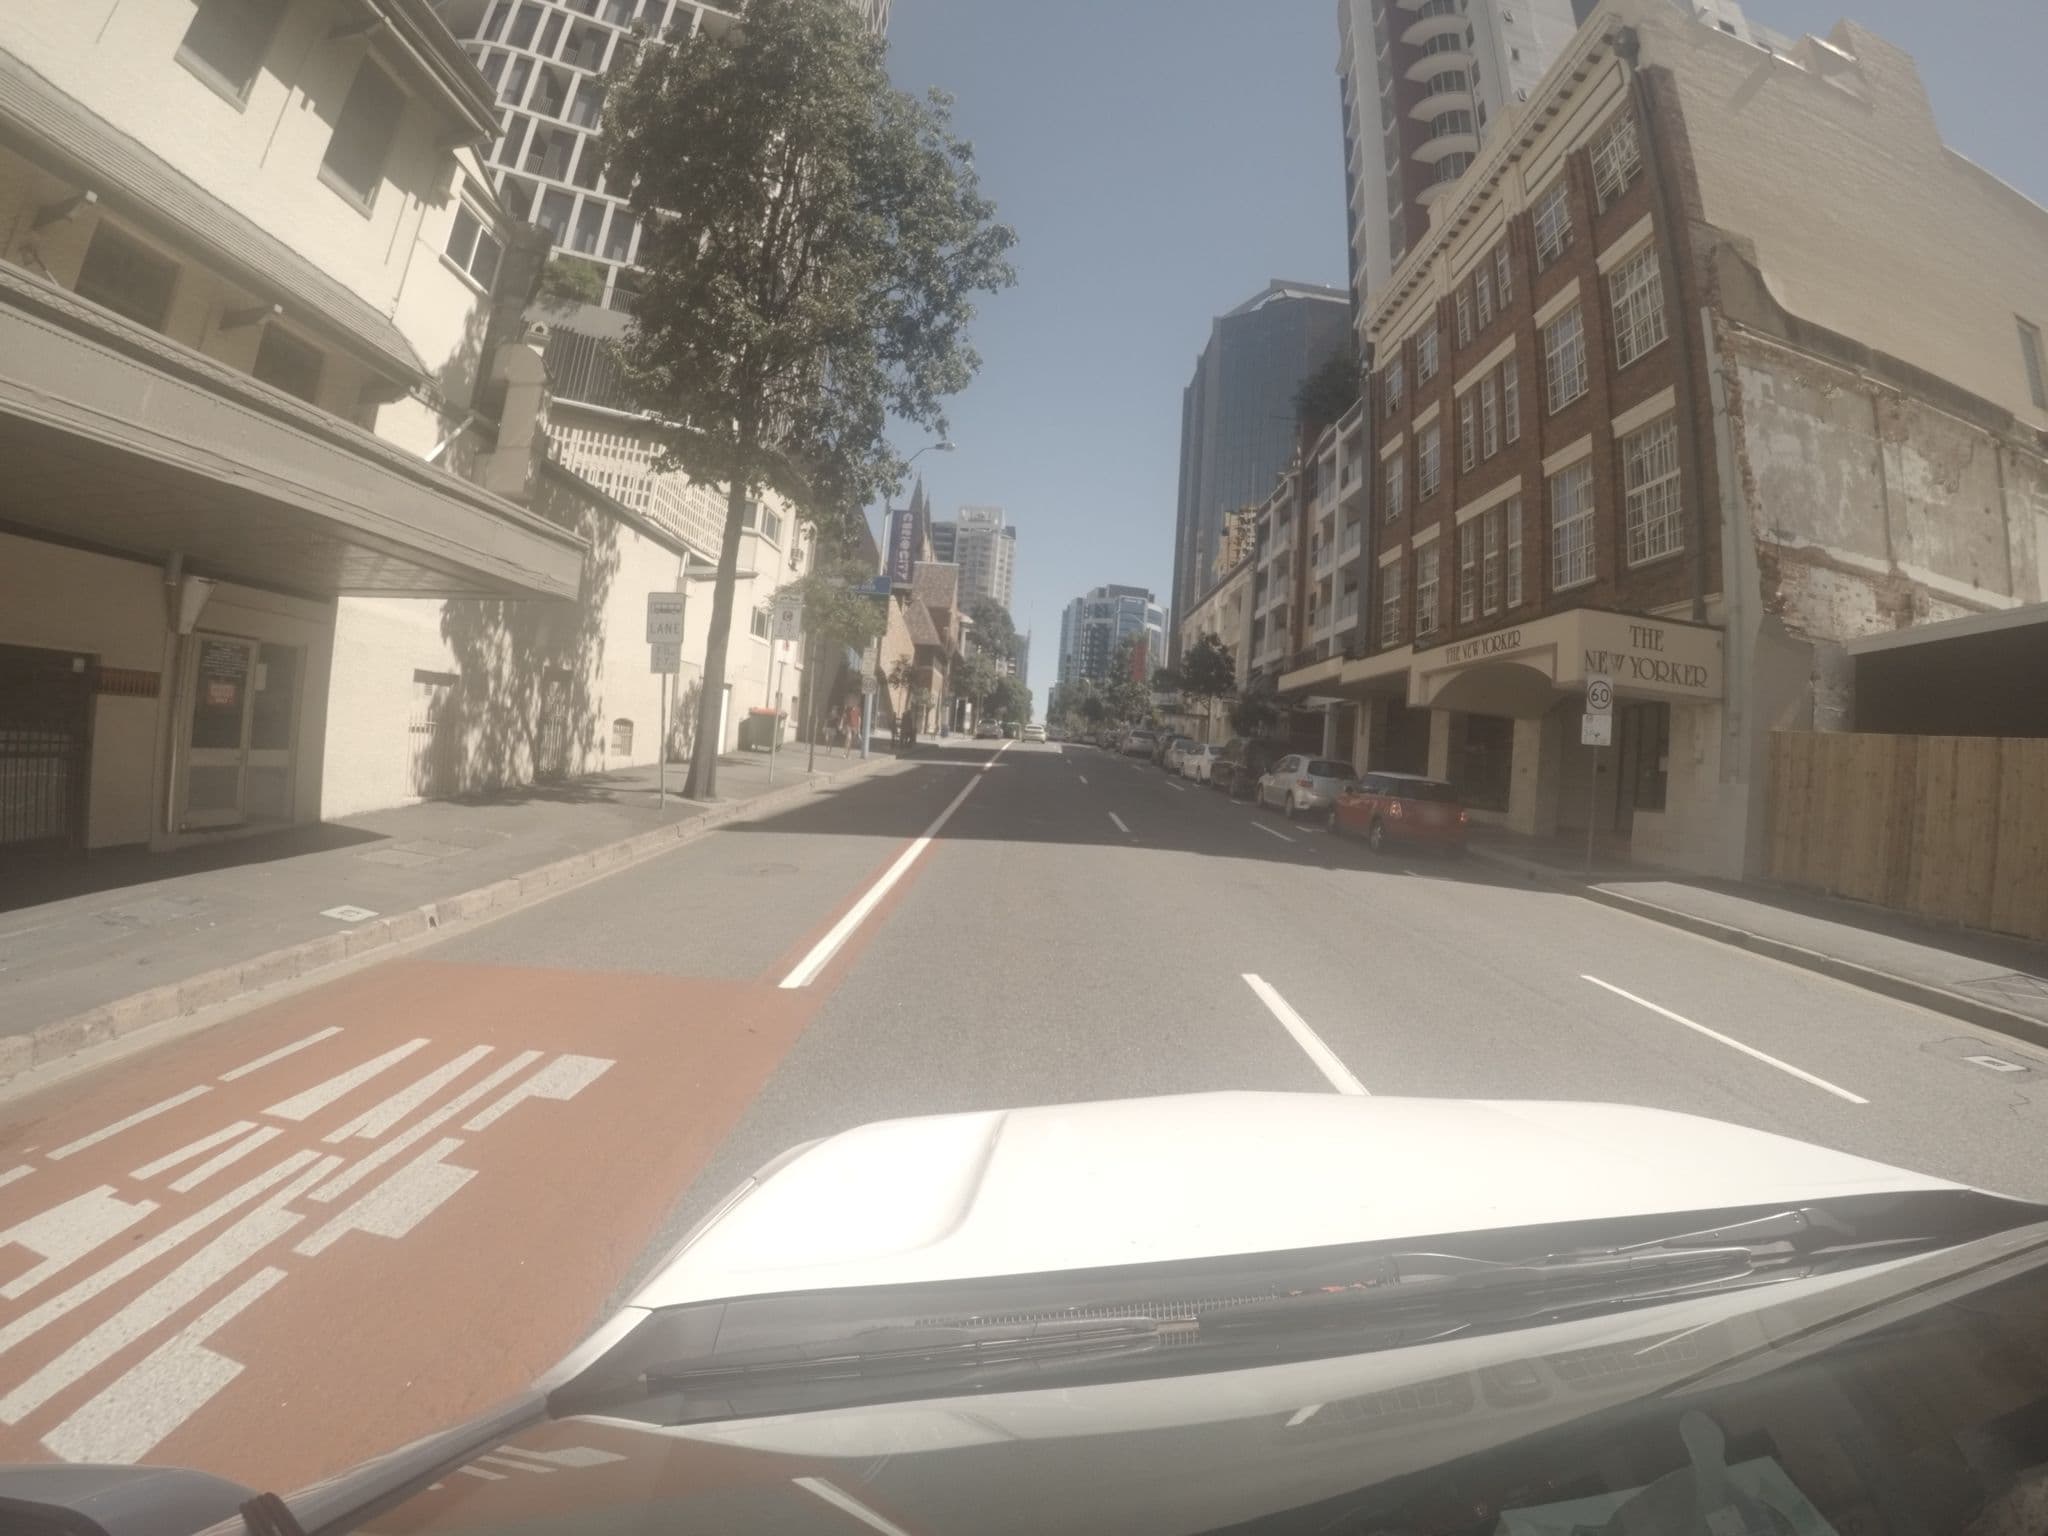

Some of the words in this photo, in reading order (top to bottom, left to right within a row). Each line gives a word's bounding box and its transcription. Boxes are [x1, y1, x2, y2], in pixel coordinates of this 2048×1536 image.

[649, 623, 680, 634] LANE
[1629, 625, 1664, 652] THE
[1446, 646, 1460, 665] THE
[1462, 639, 1480, 659] NEW
[1481, 630, 1520, 655] YORKER
[1584, 649, 1625, 675] NEW
[1630, 656, 1708, 688] YORKER
[1590, 688, 1609, 703] 60
